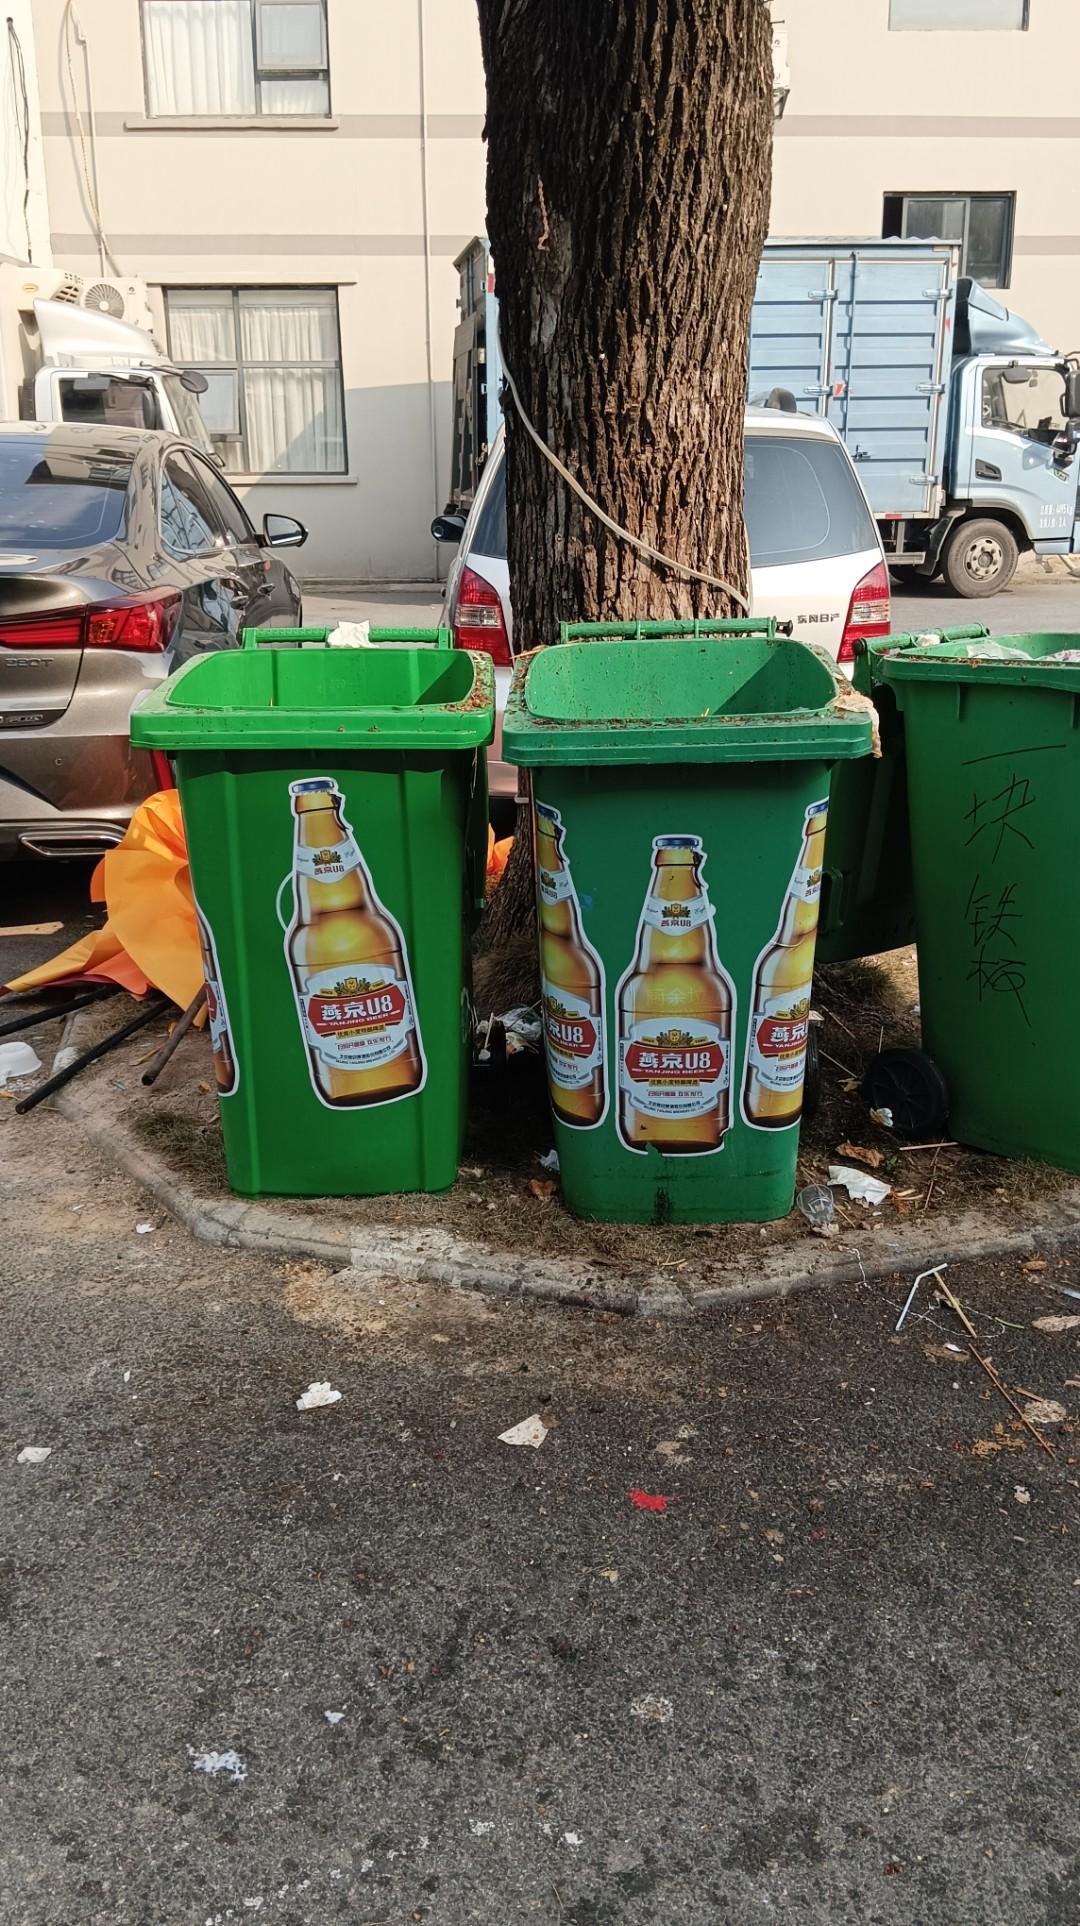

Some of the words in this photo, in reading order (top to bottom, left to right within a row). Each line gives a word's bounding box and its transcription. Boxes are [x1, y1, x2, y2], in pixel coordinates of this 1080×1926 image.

[798, 613, 840, 624] 东风日产
[321, 995, 393, 1021] 燕京U8
[549, 1020, 583, 1044] 京U8
[638, 1052, 711, 1069] 燕京U8
